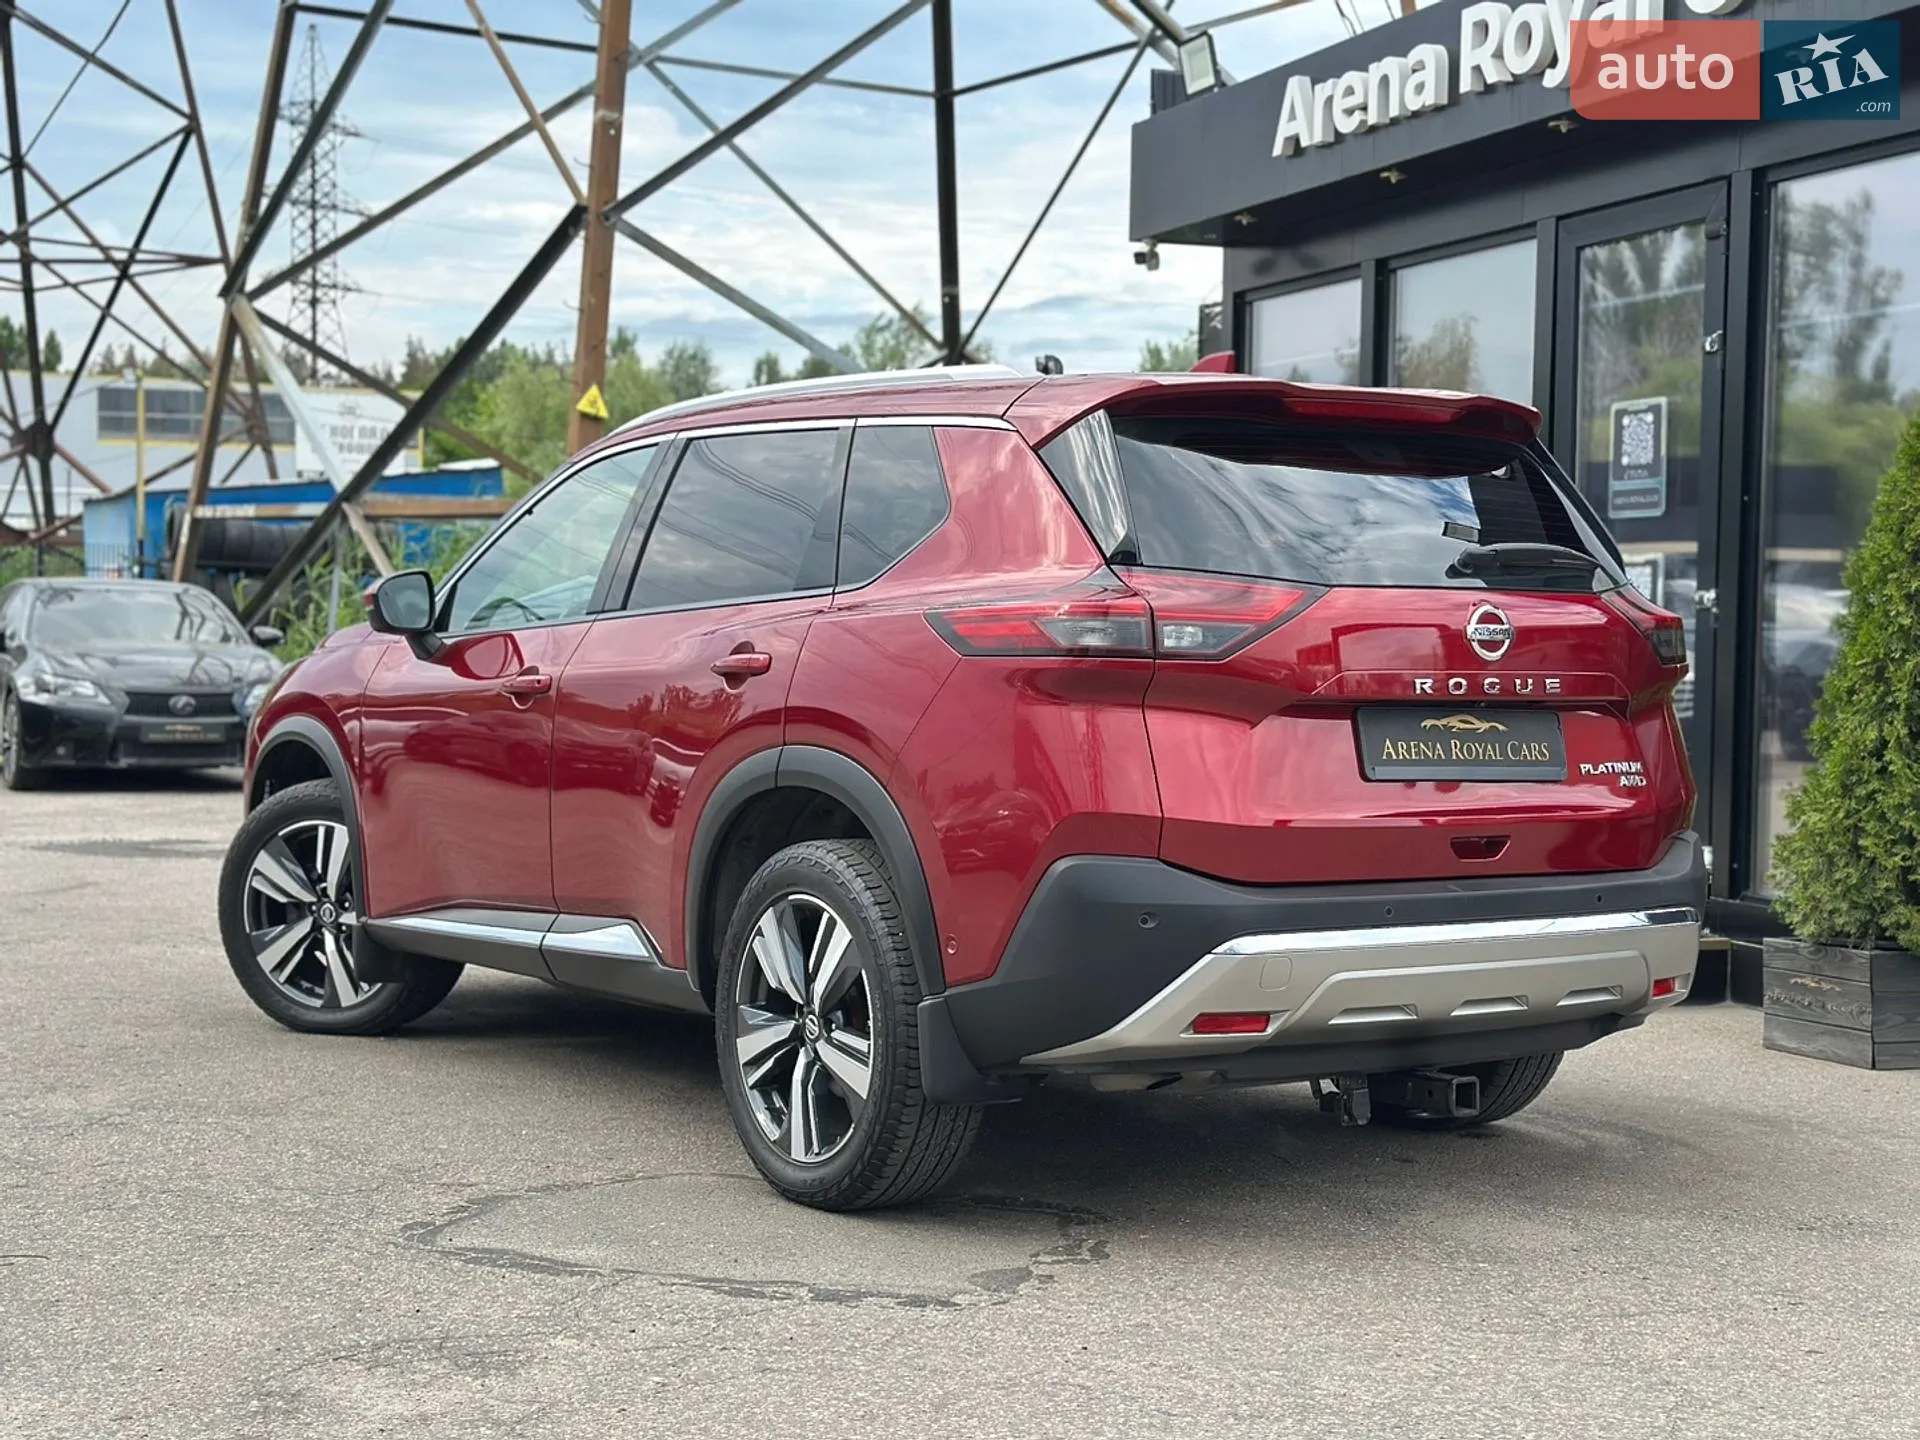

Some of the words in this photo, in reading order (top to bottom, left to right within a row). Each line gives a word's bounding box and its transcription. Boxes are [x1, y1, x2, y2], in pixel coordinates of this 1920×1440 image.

[1271, 43, 1449, 158] Arena
[1472, 626, 1511, 637] NISSAN
[1414, 677, 1562, 696] ROGUE
[1382, 738, 1446, 760] ARENA
[1450, 739, 1504, 760] ROYAL
[1507, 740, 1550, 761] CARS
[1579, 761, 1644, 776] PLATINUM
[1619, 775, 1647, 787] AWD
